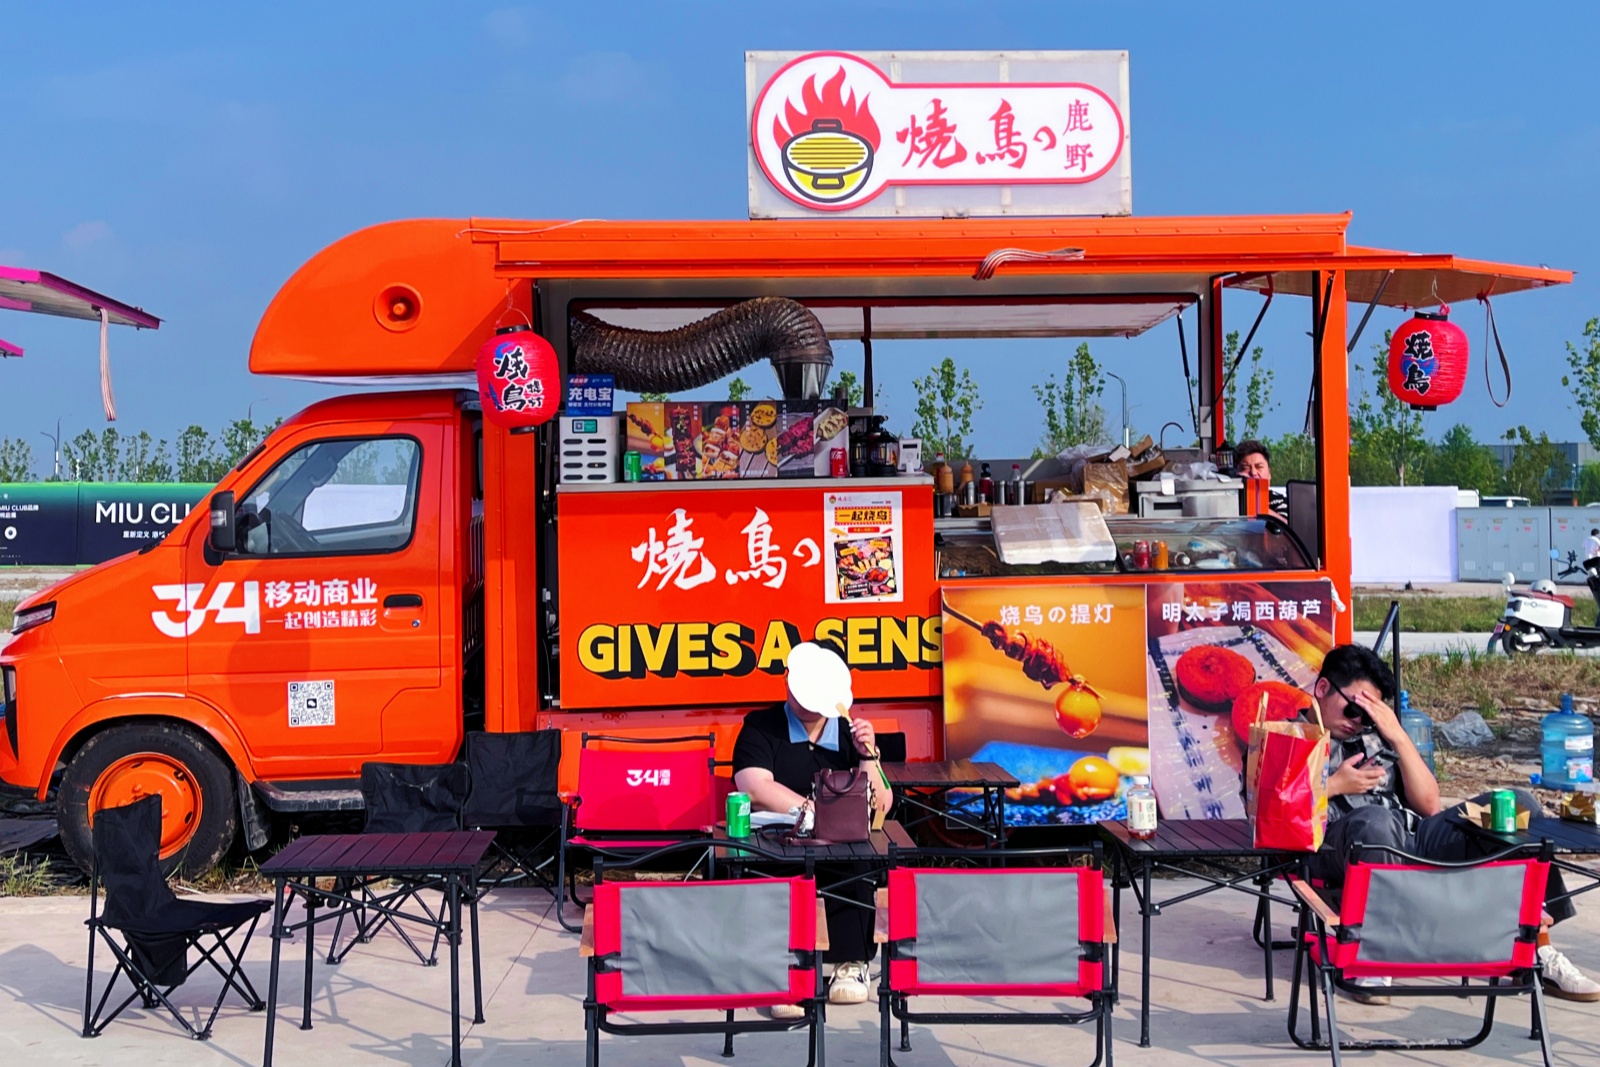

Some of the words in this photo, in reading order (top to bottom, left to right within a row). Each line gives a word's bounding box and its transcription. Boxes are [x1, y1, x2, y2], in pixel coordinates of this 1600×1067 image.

[1062, 99, 1094, 172] 鹿野
[568, 387, 612, 401] 充电宝
[95, 502, 143, 524] MIU
[839, 510, 888, 521] 一起烧鸟
[264, 578, 378, 608] 移动商业
[151, 581, 260, 637] 34
[265, 608, 378, 630] 一起创造精彩
[999, 603, 1115, 626] 烧鸟の提灯
[1162, 599, 1322, 623] 明太子焗西葫芦
[577, 621, 753, 677] GIVES
[757, 620, 799, 672] A
[626, 769, 659, 787] 34
